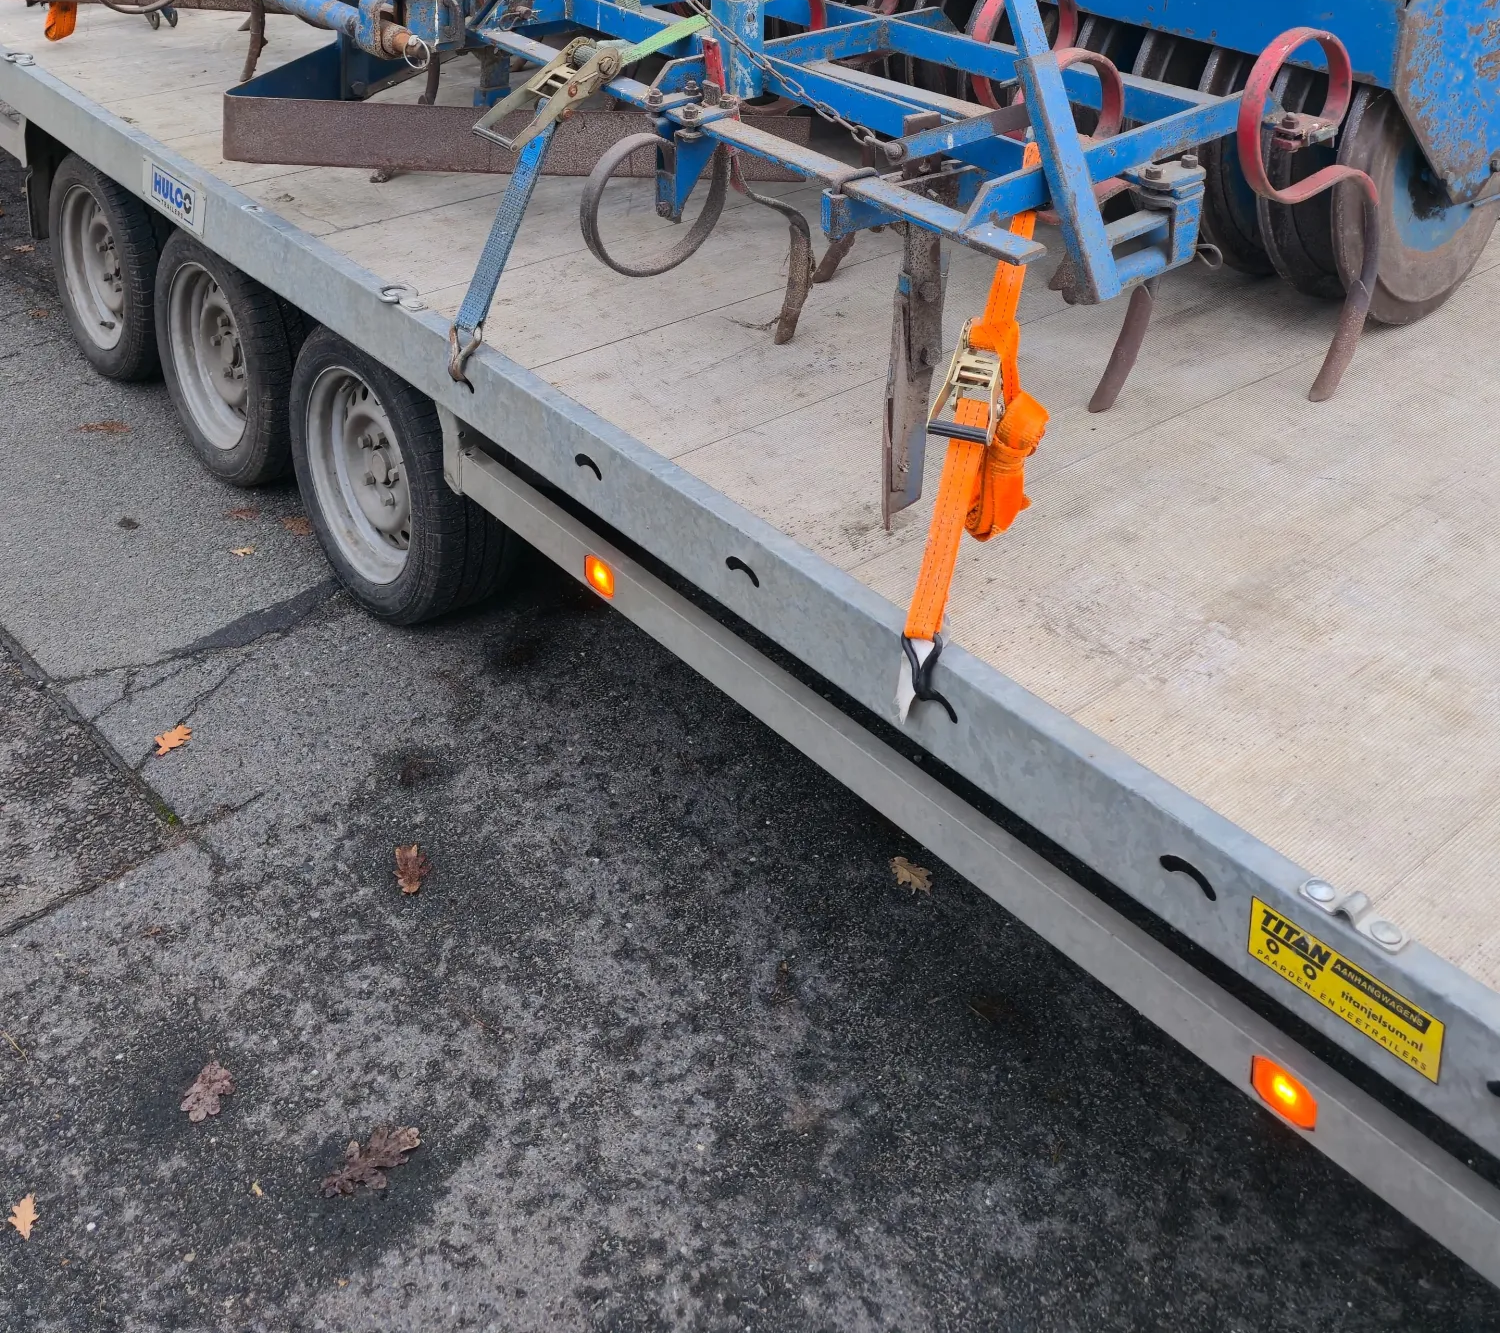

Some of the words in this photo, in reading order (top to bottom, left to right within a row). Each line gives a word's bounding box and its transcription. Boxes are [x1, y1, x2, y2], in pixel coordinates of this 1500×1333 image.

[154, 172, 192, 215] HULCO
[161, 199, 184, 220] TRAILERS
[1261, 909, 1332, 966] TITAN
[1334, 963, 1424, 1027] AANHANGWAGENS
[1340, 990, 1424, 1053] titanjelsum.nl
[1320, 992, 1335, 1006] EN
[1339, 1006, 1427, 1071] VEETRAILERS
